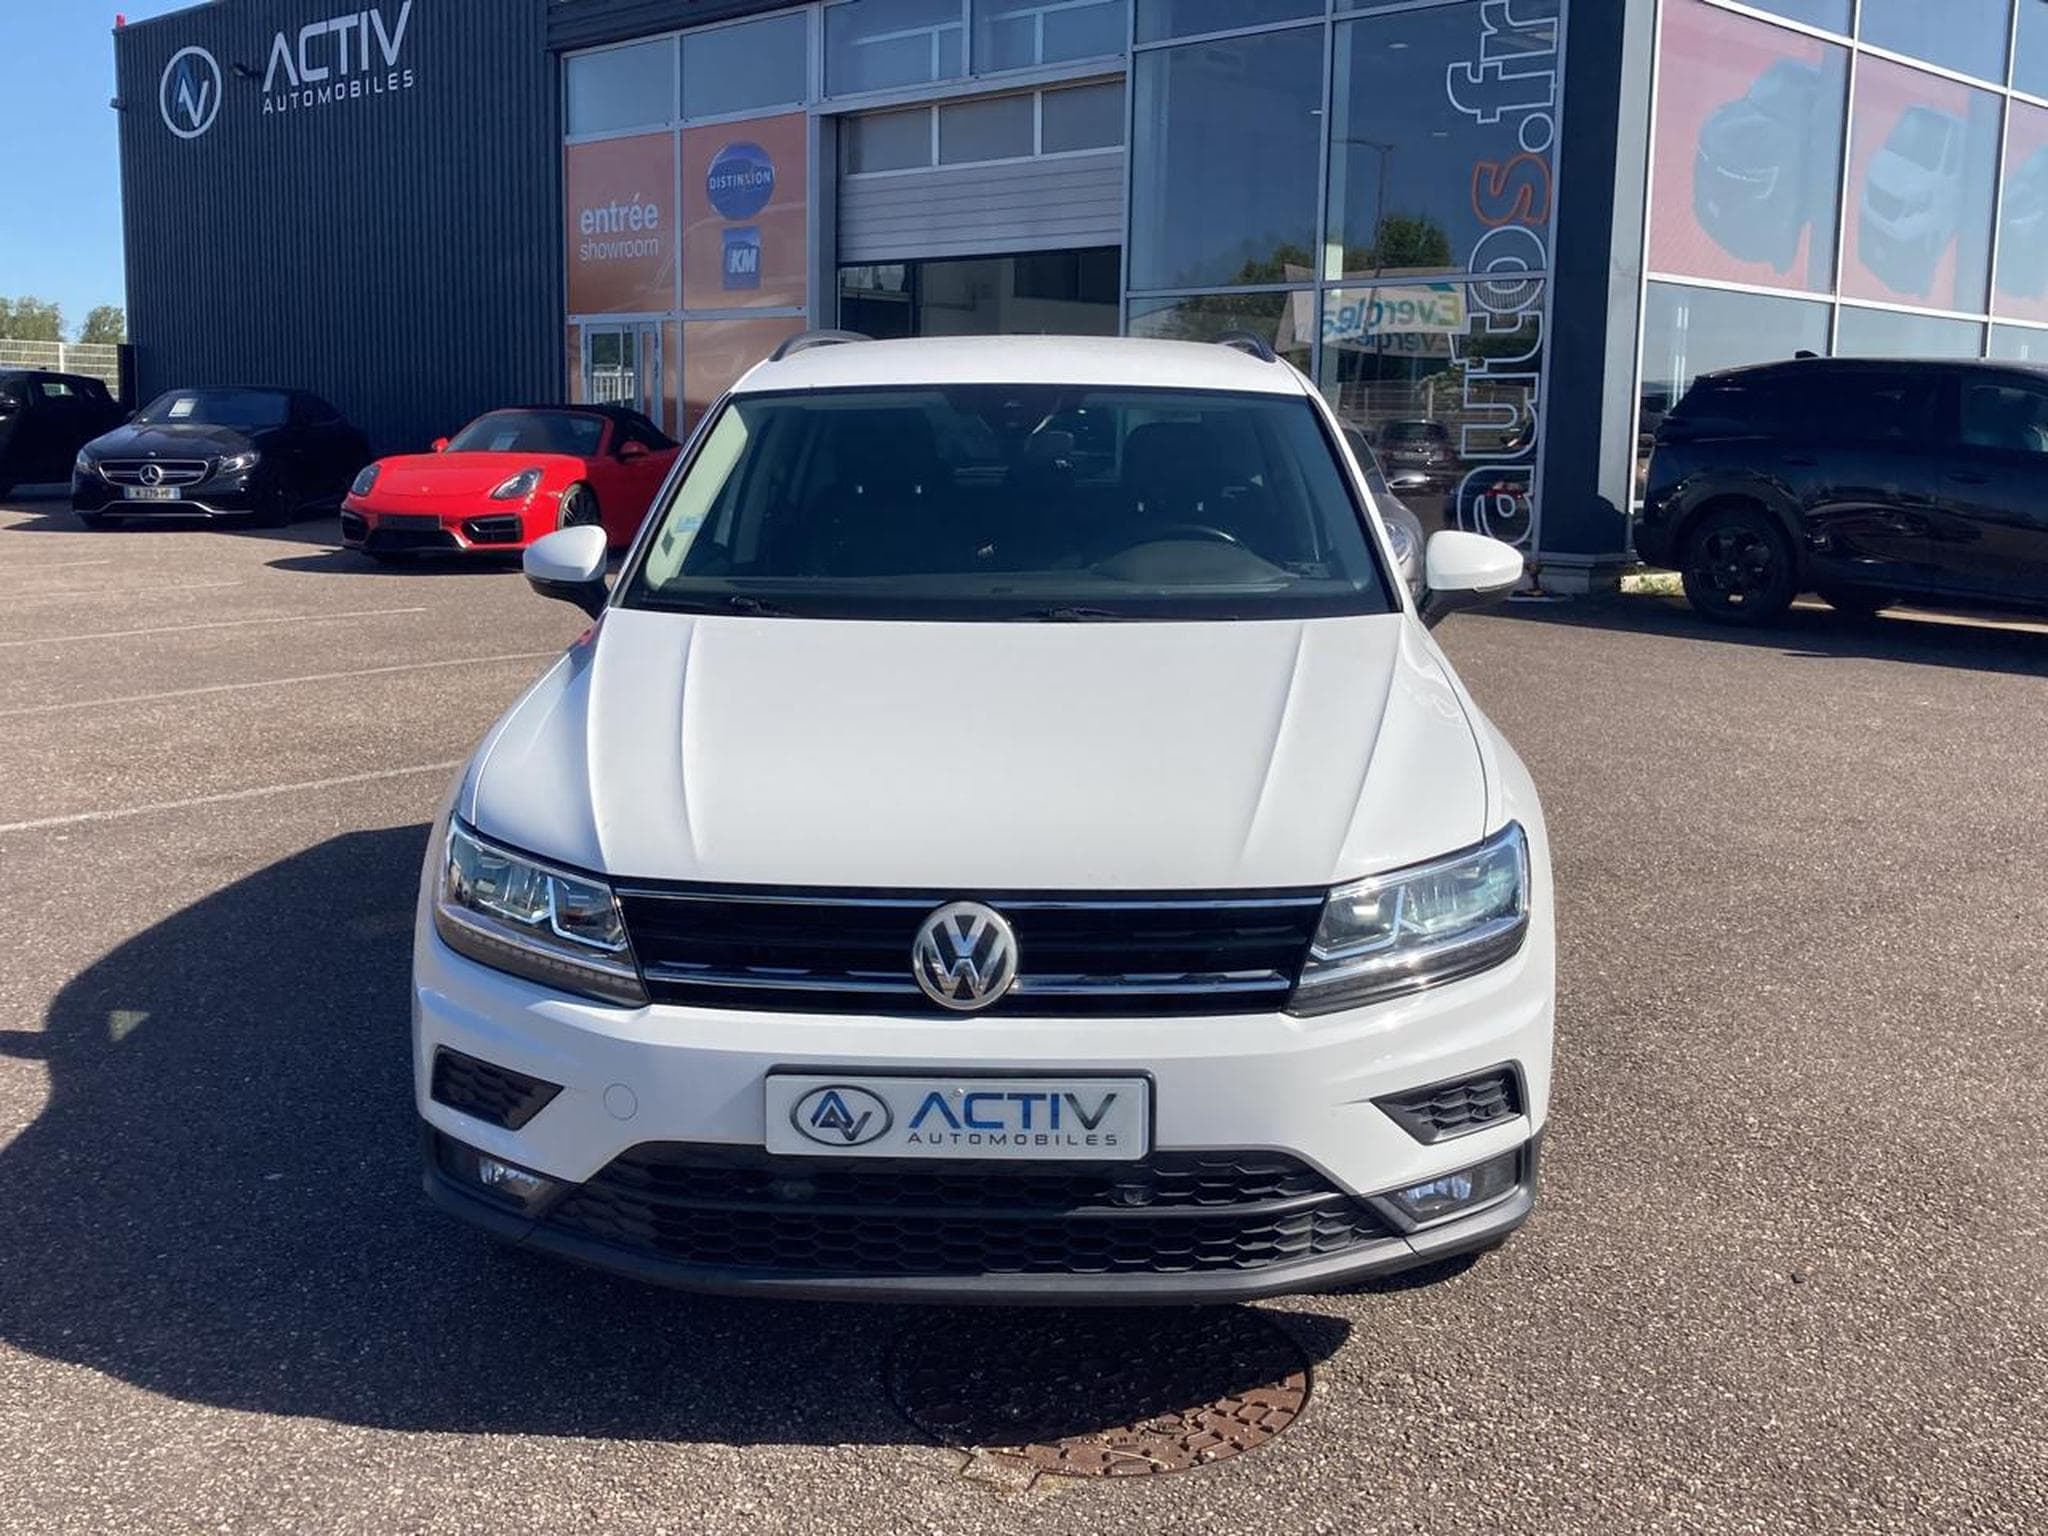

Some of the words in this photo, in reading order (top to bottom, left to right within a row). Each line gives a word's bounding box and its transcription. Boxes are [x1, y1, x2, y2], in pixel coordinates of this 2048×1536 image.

[263, 0, 412, 92] ACTIV
[263, 69, 414, 115] AUTOMOBILES
[580, 192, 659, 235] entrée
[579, 237, 660, 261] showroom
[728, 248, 758, 273] KM
[908, 1090, 1118, 1131] ACTIV
[907, 1133, 1118, 1147] AUTOMOBILES
